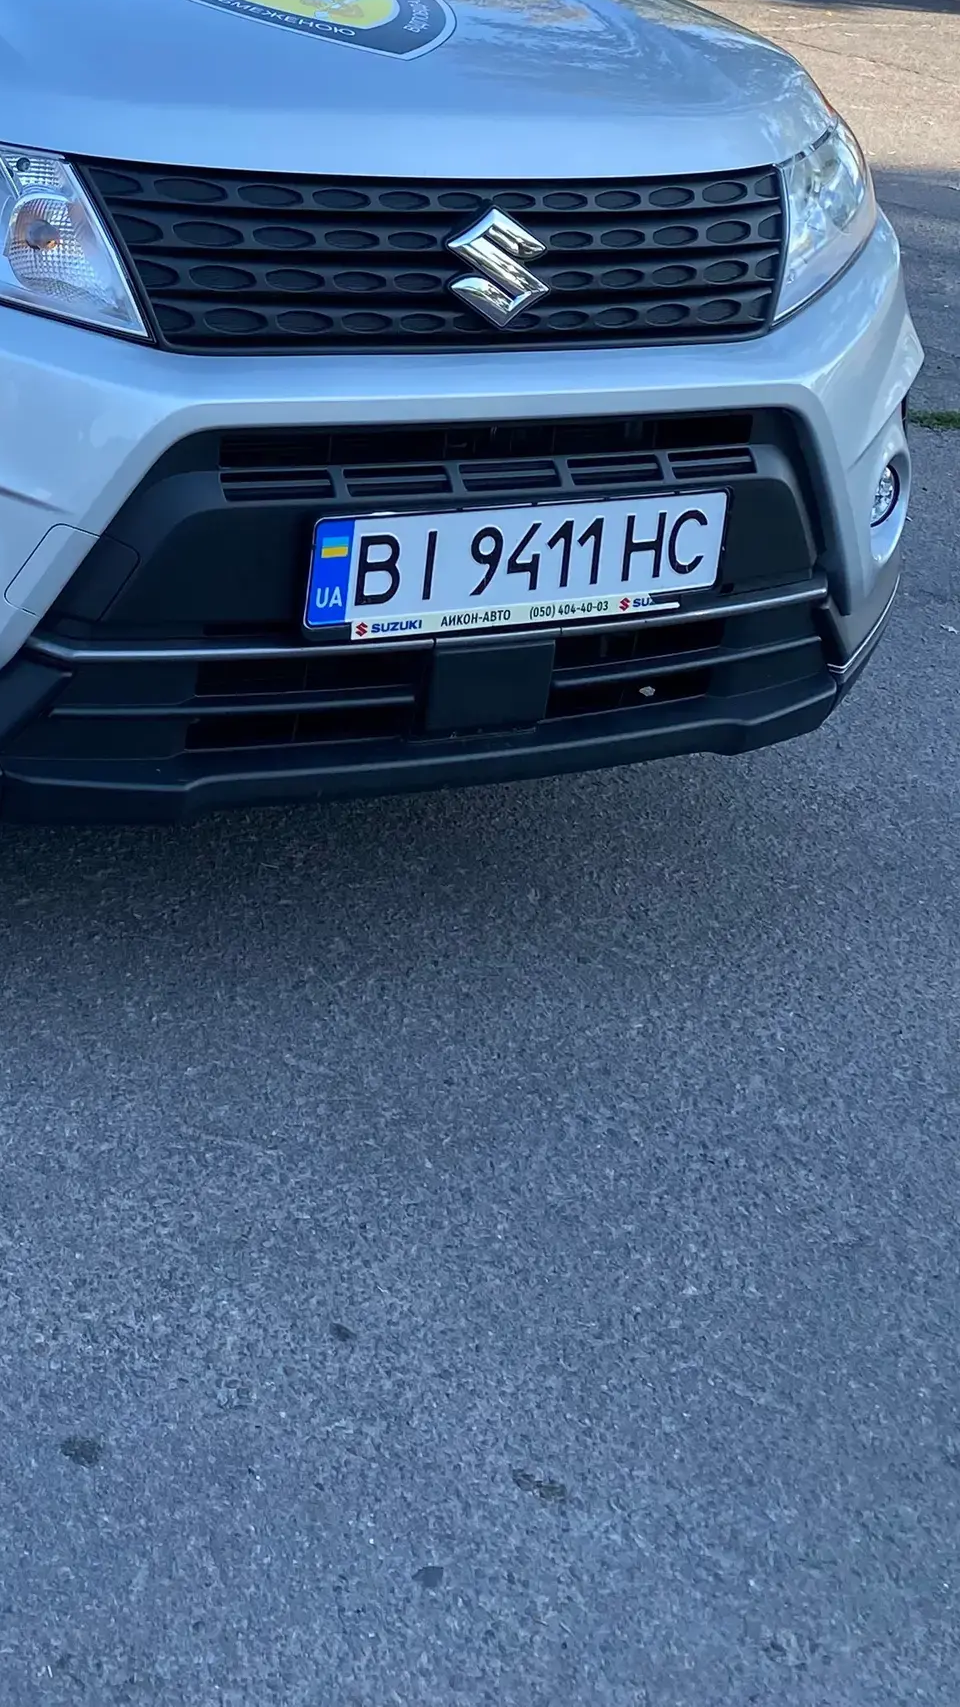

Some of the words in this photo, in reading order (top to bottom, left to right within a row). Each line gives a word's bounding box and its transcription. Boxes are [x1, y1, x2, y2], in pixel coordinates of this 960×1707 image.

[354, 530, 438, 606] BI
[469, 517, 606, 597] 9411
[621, 509, 709, 582] HC
[315, 586, 343, 609] UA
[371, 619, 423, 634] SUZUKI
[529, 603, 556, 620] (050)
[558, 600, 609, 616] 404-40-03
